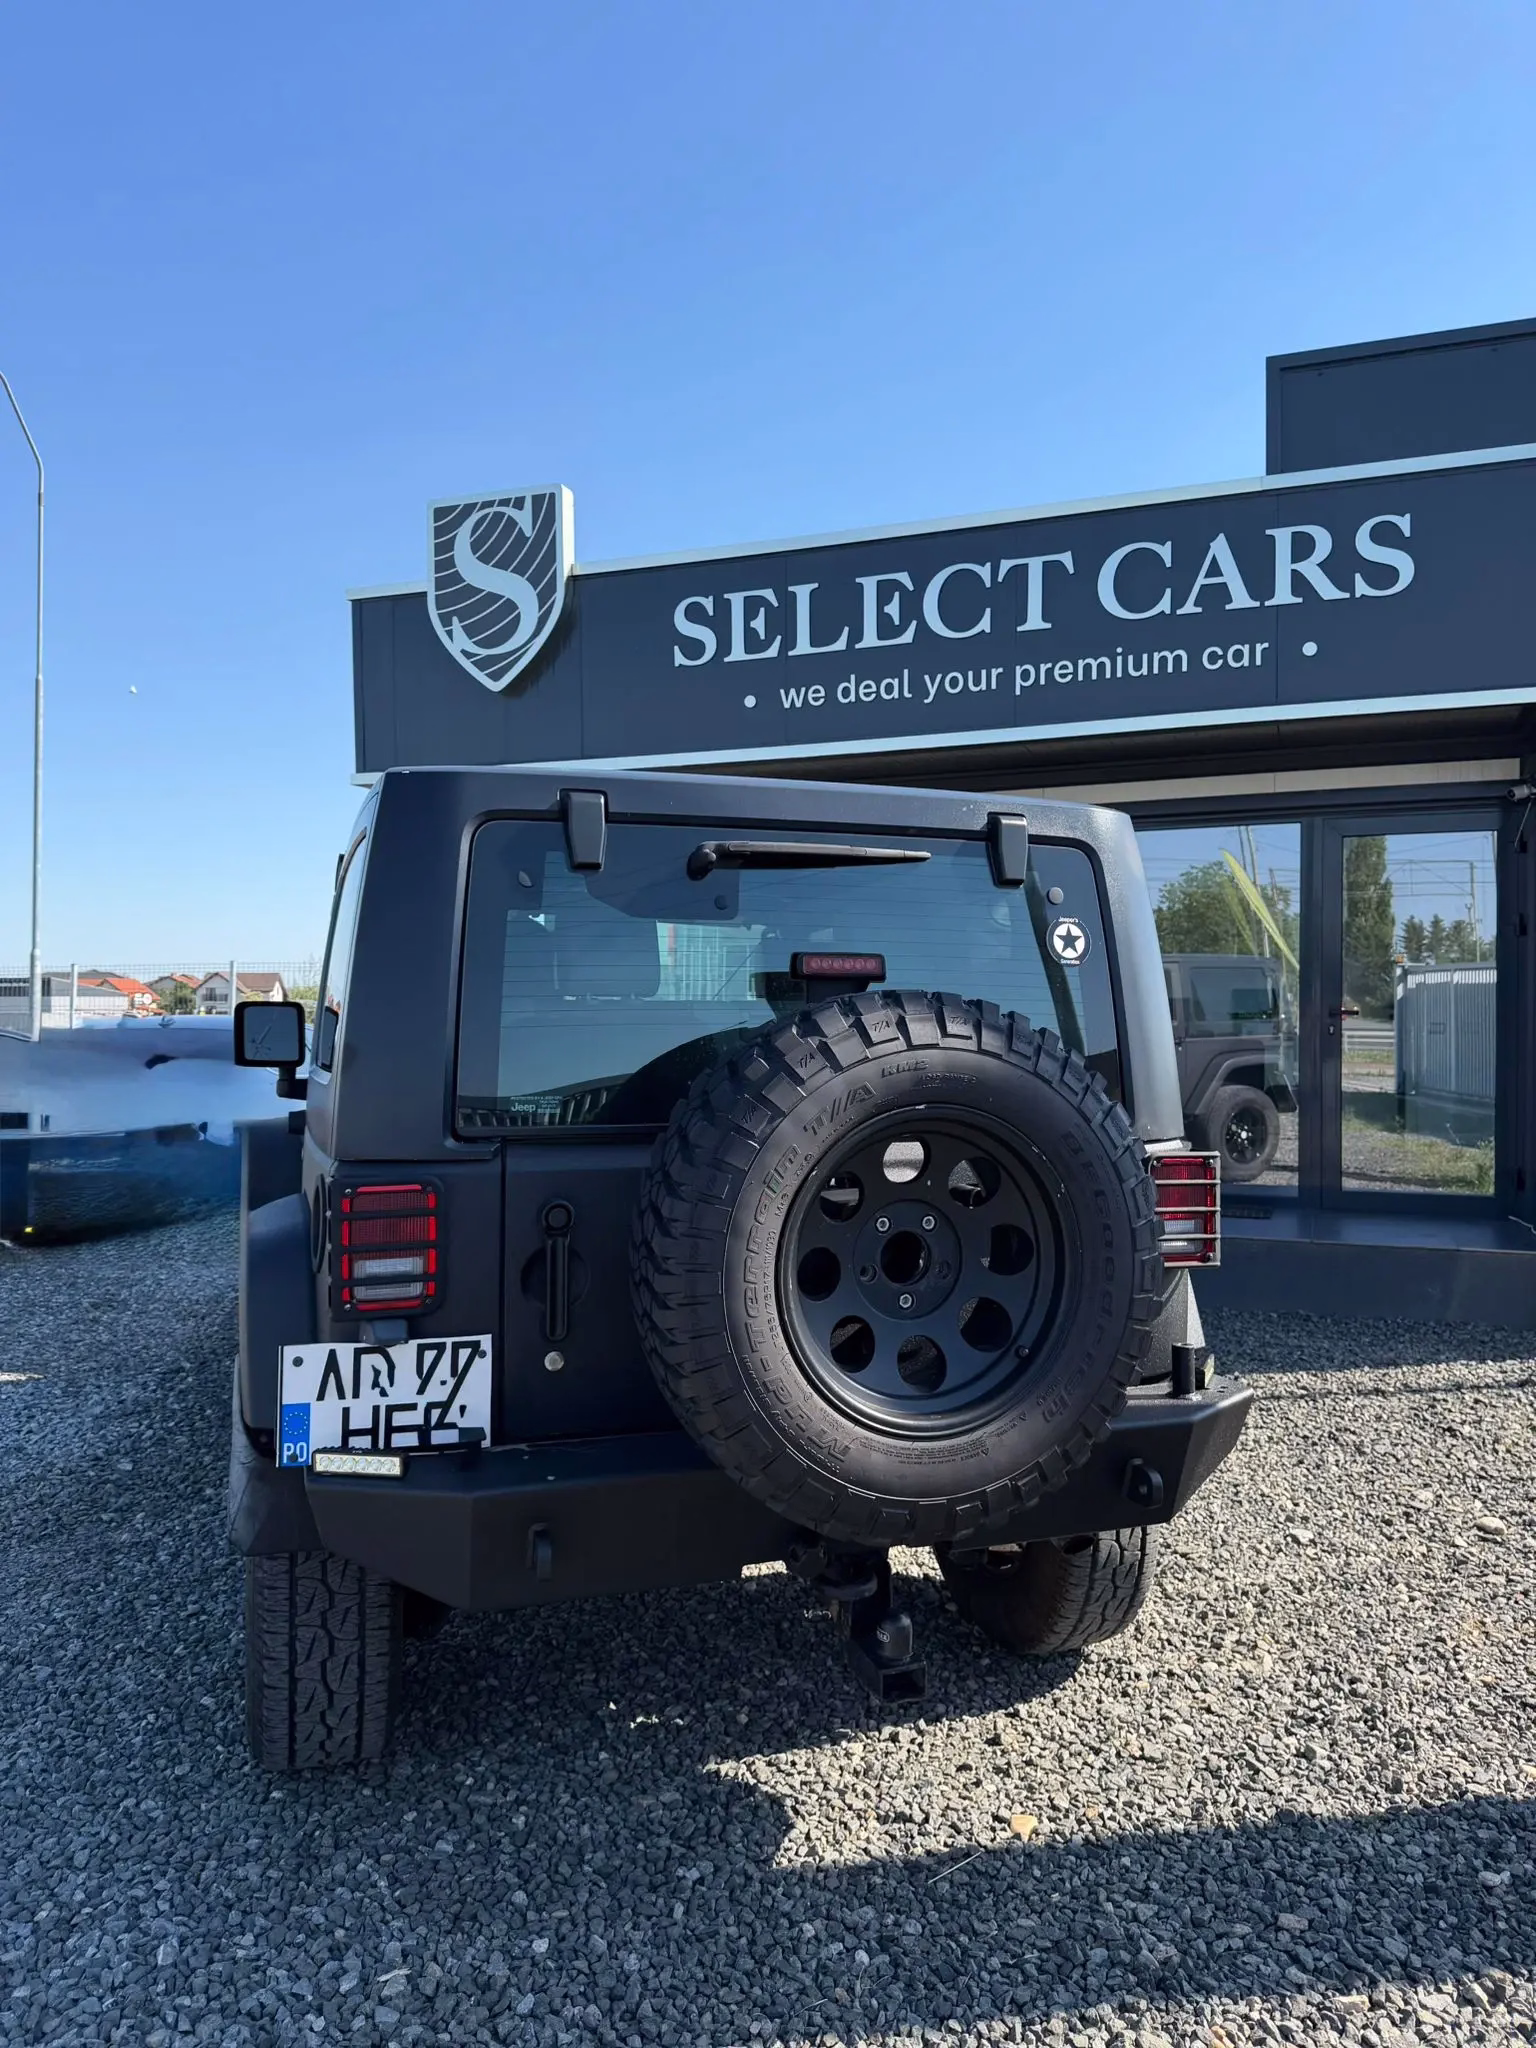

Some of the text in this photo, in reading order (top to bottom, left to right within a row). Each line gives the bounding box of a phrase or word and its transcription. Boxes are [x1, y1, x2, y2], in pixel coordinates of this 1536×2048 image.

[672, 511, 1416, 668] SELECT CARS
[779, 641, 1270, 709] we deal your premium car
[510, 1102, 537, 1113] Jeep
